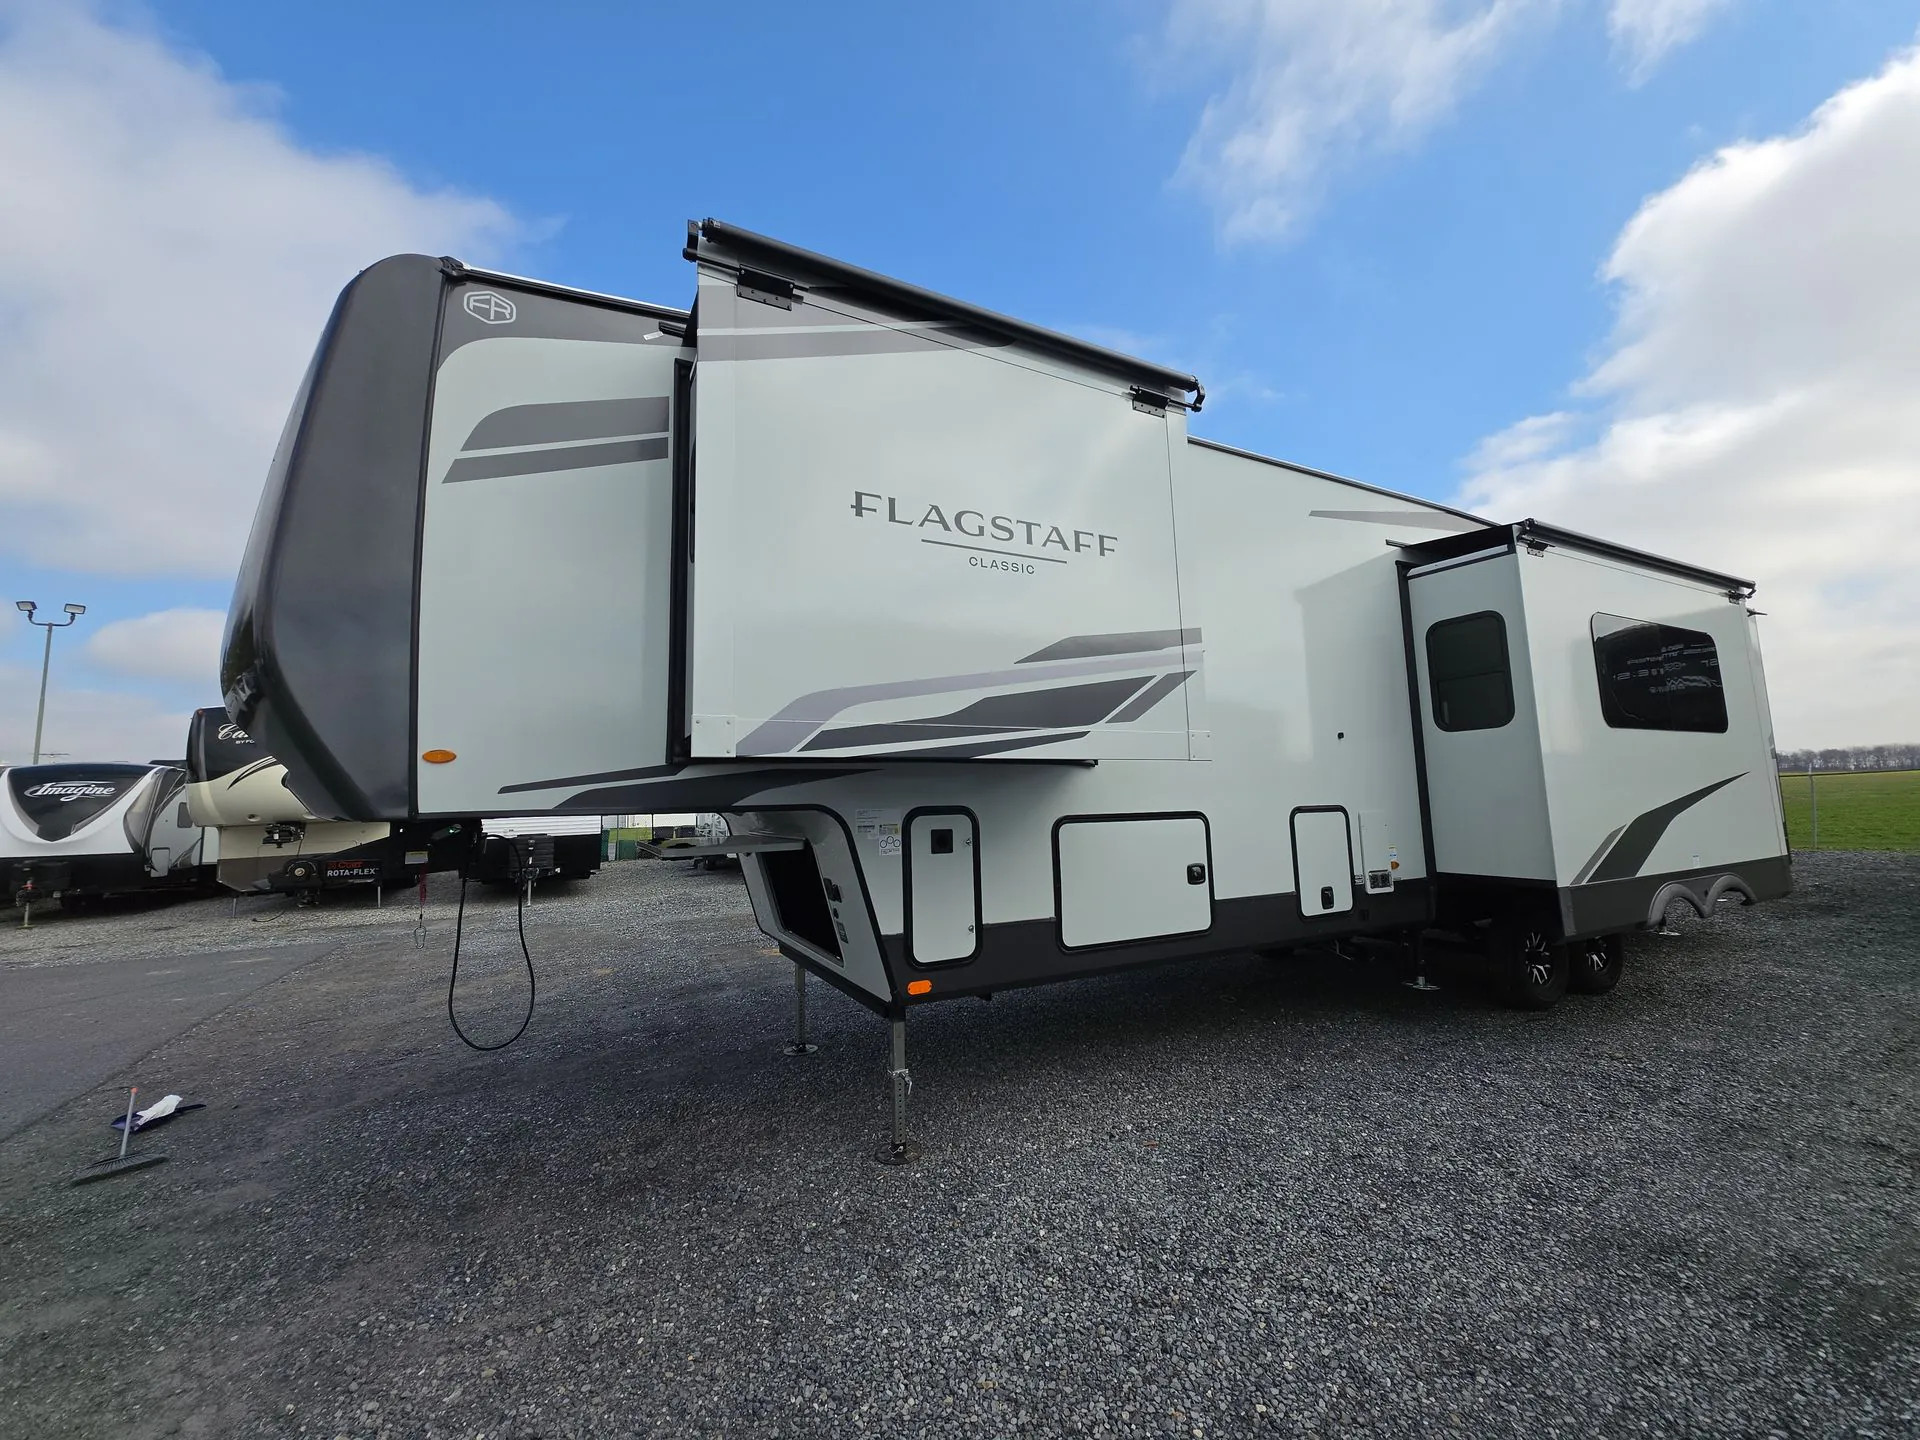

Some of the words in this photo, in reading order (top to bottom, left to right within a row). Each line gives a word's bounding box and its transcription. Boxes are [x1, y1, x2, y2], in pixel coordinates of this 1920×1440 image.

[850, 490, 1119, 557] FLAGSTAFF
[968, 556, 1036, 575] CLASSIC
[27, 781, 117, 802] Imagine
[327, 867, 377, 877] ROTA-FLEX
